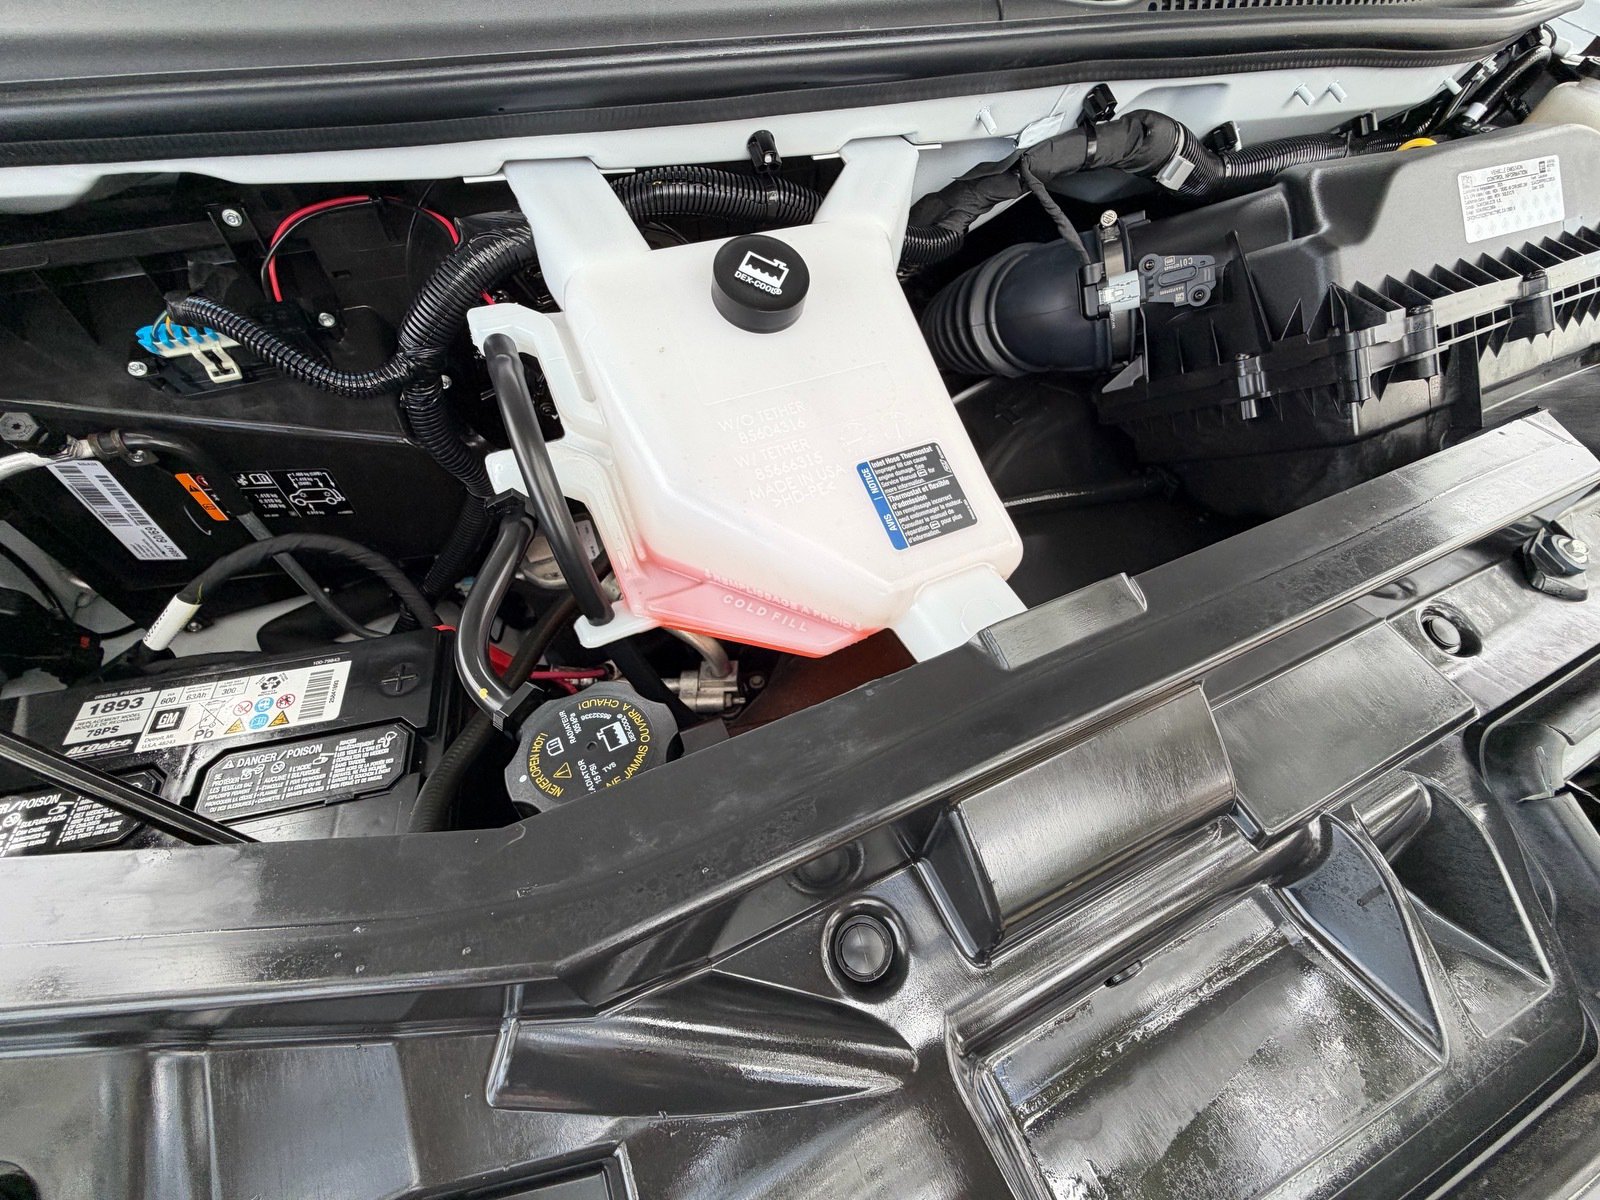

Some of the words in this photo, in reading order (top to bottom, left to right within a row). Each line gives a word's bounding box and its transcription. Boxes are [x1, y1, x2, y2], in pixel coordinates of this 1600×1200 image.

[758, 400, 805, 421] TETHER
[762, 438, 810, 459] TETHER
[870, 459, 885, 468] Inlet
[884, 455, 900, 463] Hose
[899, 445, 933, 459] Thermostat
[750, 476, 798, 500] MADE
[798, 471, 814, 486] IN
[816, 464, 847, 481] USA
[861, 468, 879, 494] NOTICE
[880, 477, 899, 487] Service
[898, 472, 917, 481] Manual
[887, 487, 921, 502] Thermostat
[930, 494, 952, 504] incorrect
[884, 514, 898, 531] AVIS
[722, 594, 768, 617] COLD
[771, 612, 808, 632] FILL
[90, 697, 144, 716] 1893
[160, 696, 176, 705] 600
[186, 692, 207, 701] 63Ah
[222, 687, 236, 695] 300
[156, 712, 180, 729] GM
[558, 710, 576, 744] RADIATEUR
[628, 708, 650, 742] OUVRIR
[86, 726, 120, 738] 78PS
[194, 729, 214, 741] Pb
[529, 752, 541, 778] OPEN
[624, 744, 648, 779] JAMAIS
[534, 772, 564, 797] NEVER
[578, 758, 596, 794] ADIATOR
